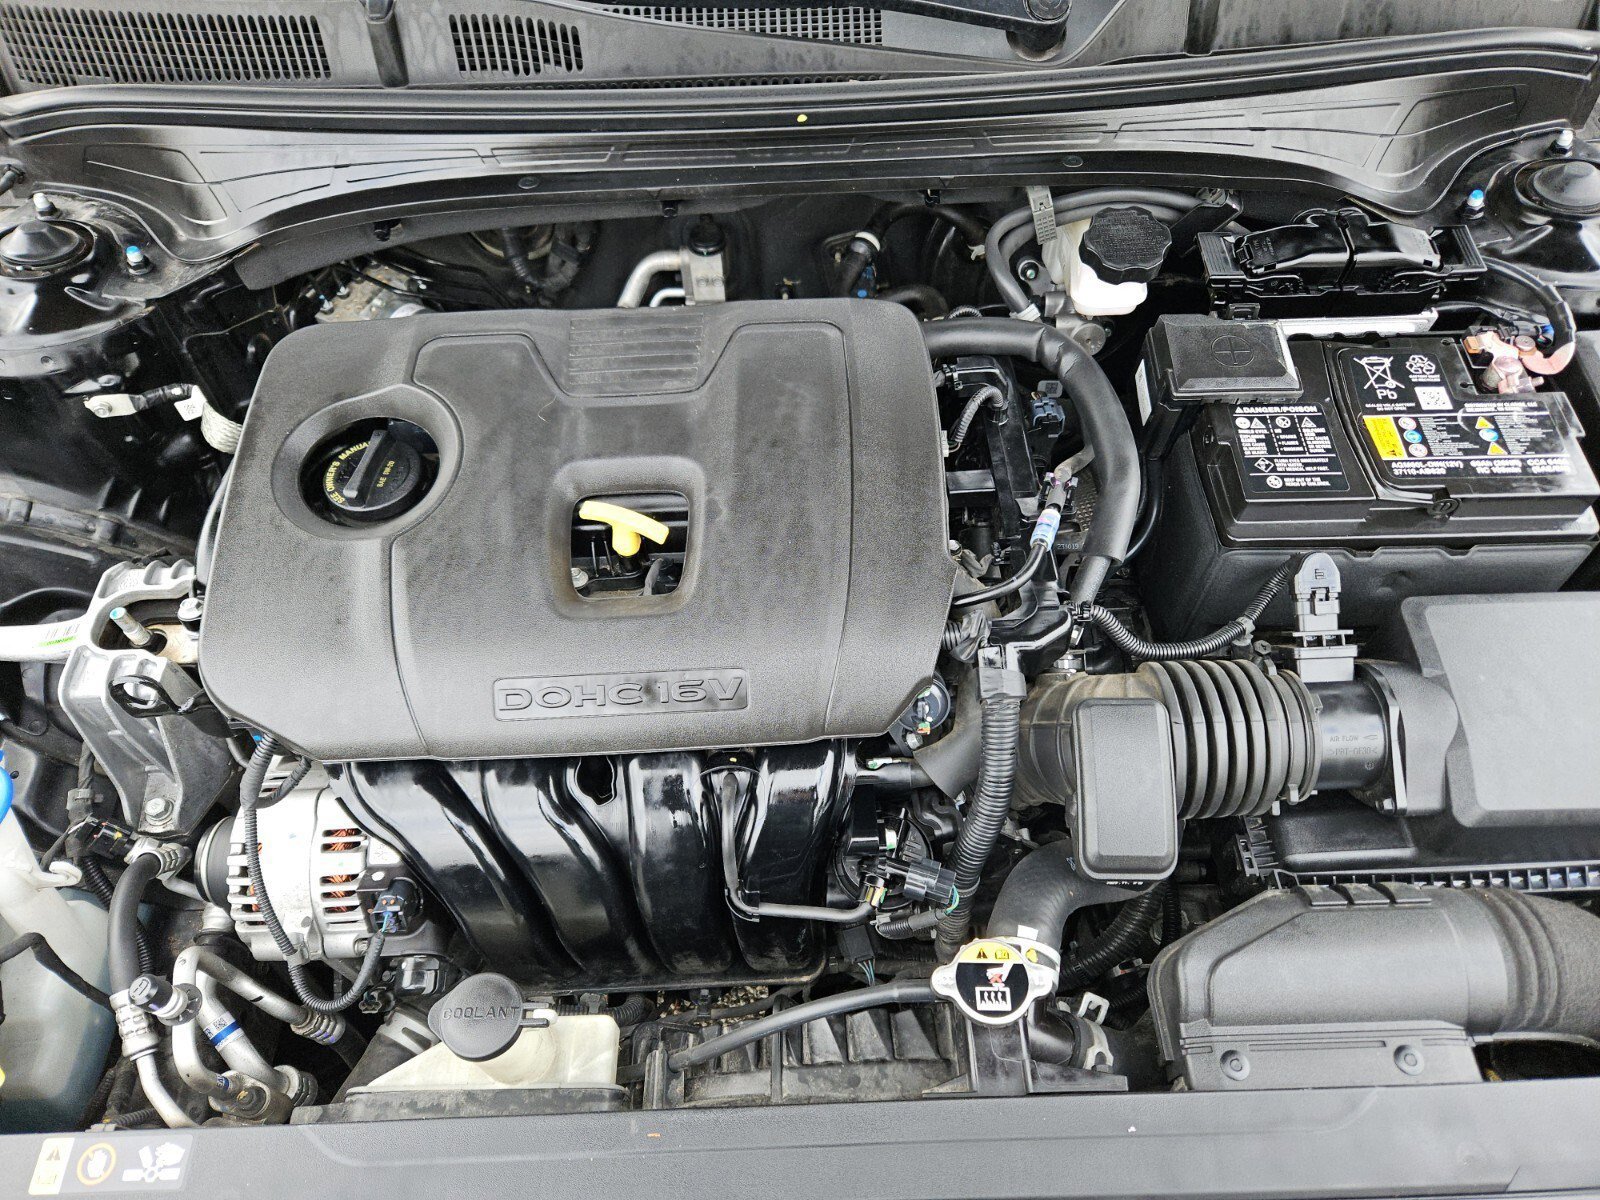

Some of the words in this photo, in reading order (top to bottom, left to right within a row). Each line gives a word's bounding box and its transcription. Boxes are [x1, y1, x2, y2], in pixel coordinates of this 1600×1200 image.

[1376, 389, 1398, 399] Pb
[1242, 405, 1318, 413] DANGER/POISON
[338, 440, 371, 460] MANUA
[325, 460, 341, 492] OWNER'S
[329, 491, 346, 504] SEE
[498, 682, 643, 711] DOHC
[657, 676, 743, 703] 16V
[443, 1006, 520, 1020] COOLANT
